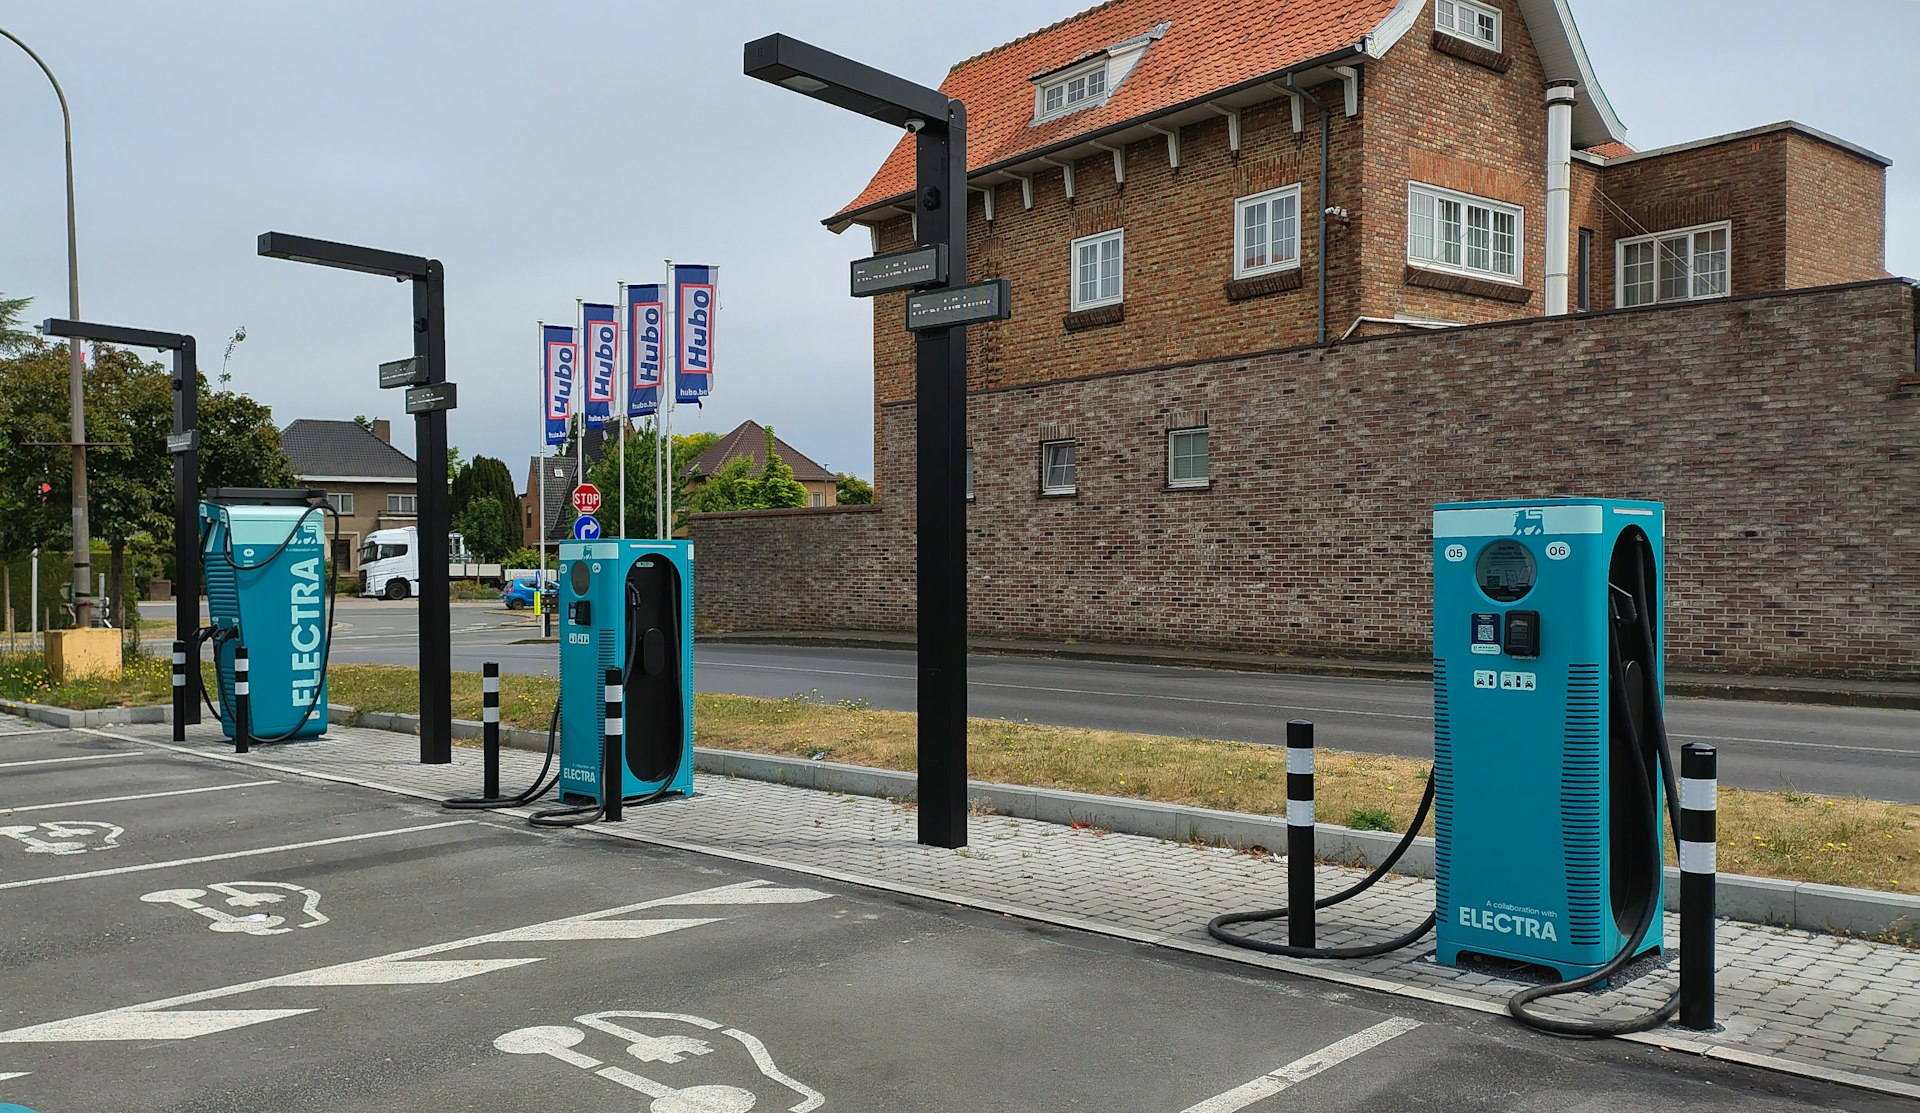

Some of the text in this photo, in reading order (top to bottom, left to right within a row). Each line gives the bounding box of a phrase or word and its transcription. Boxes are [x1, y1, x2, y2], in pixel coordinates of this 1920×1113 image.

[688, 290, 710, 368] Hubo
[640, 308, 659, 382] Hubo
[594, 326, 614, 396] Hubo
[554, 348, 573, 414] Hubo
[680, 388, 708, 397] hubo.be
[632, 400, 657, 410] hubo.be
[574, 493, 599, 505] STOP
[1448, 549, 1463, 558] 05
[1549, 546, 1566, 556] 06
[290, 557, 321, 707] ELECTRA
[563, 768, 596, 783] ELECTRA
[1493, 902, 1540, 915] collaboration
[1541, 909, 1558, 918] with
[1459, 906, 1558, 942] ELECTRA
